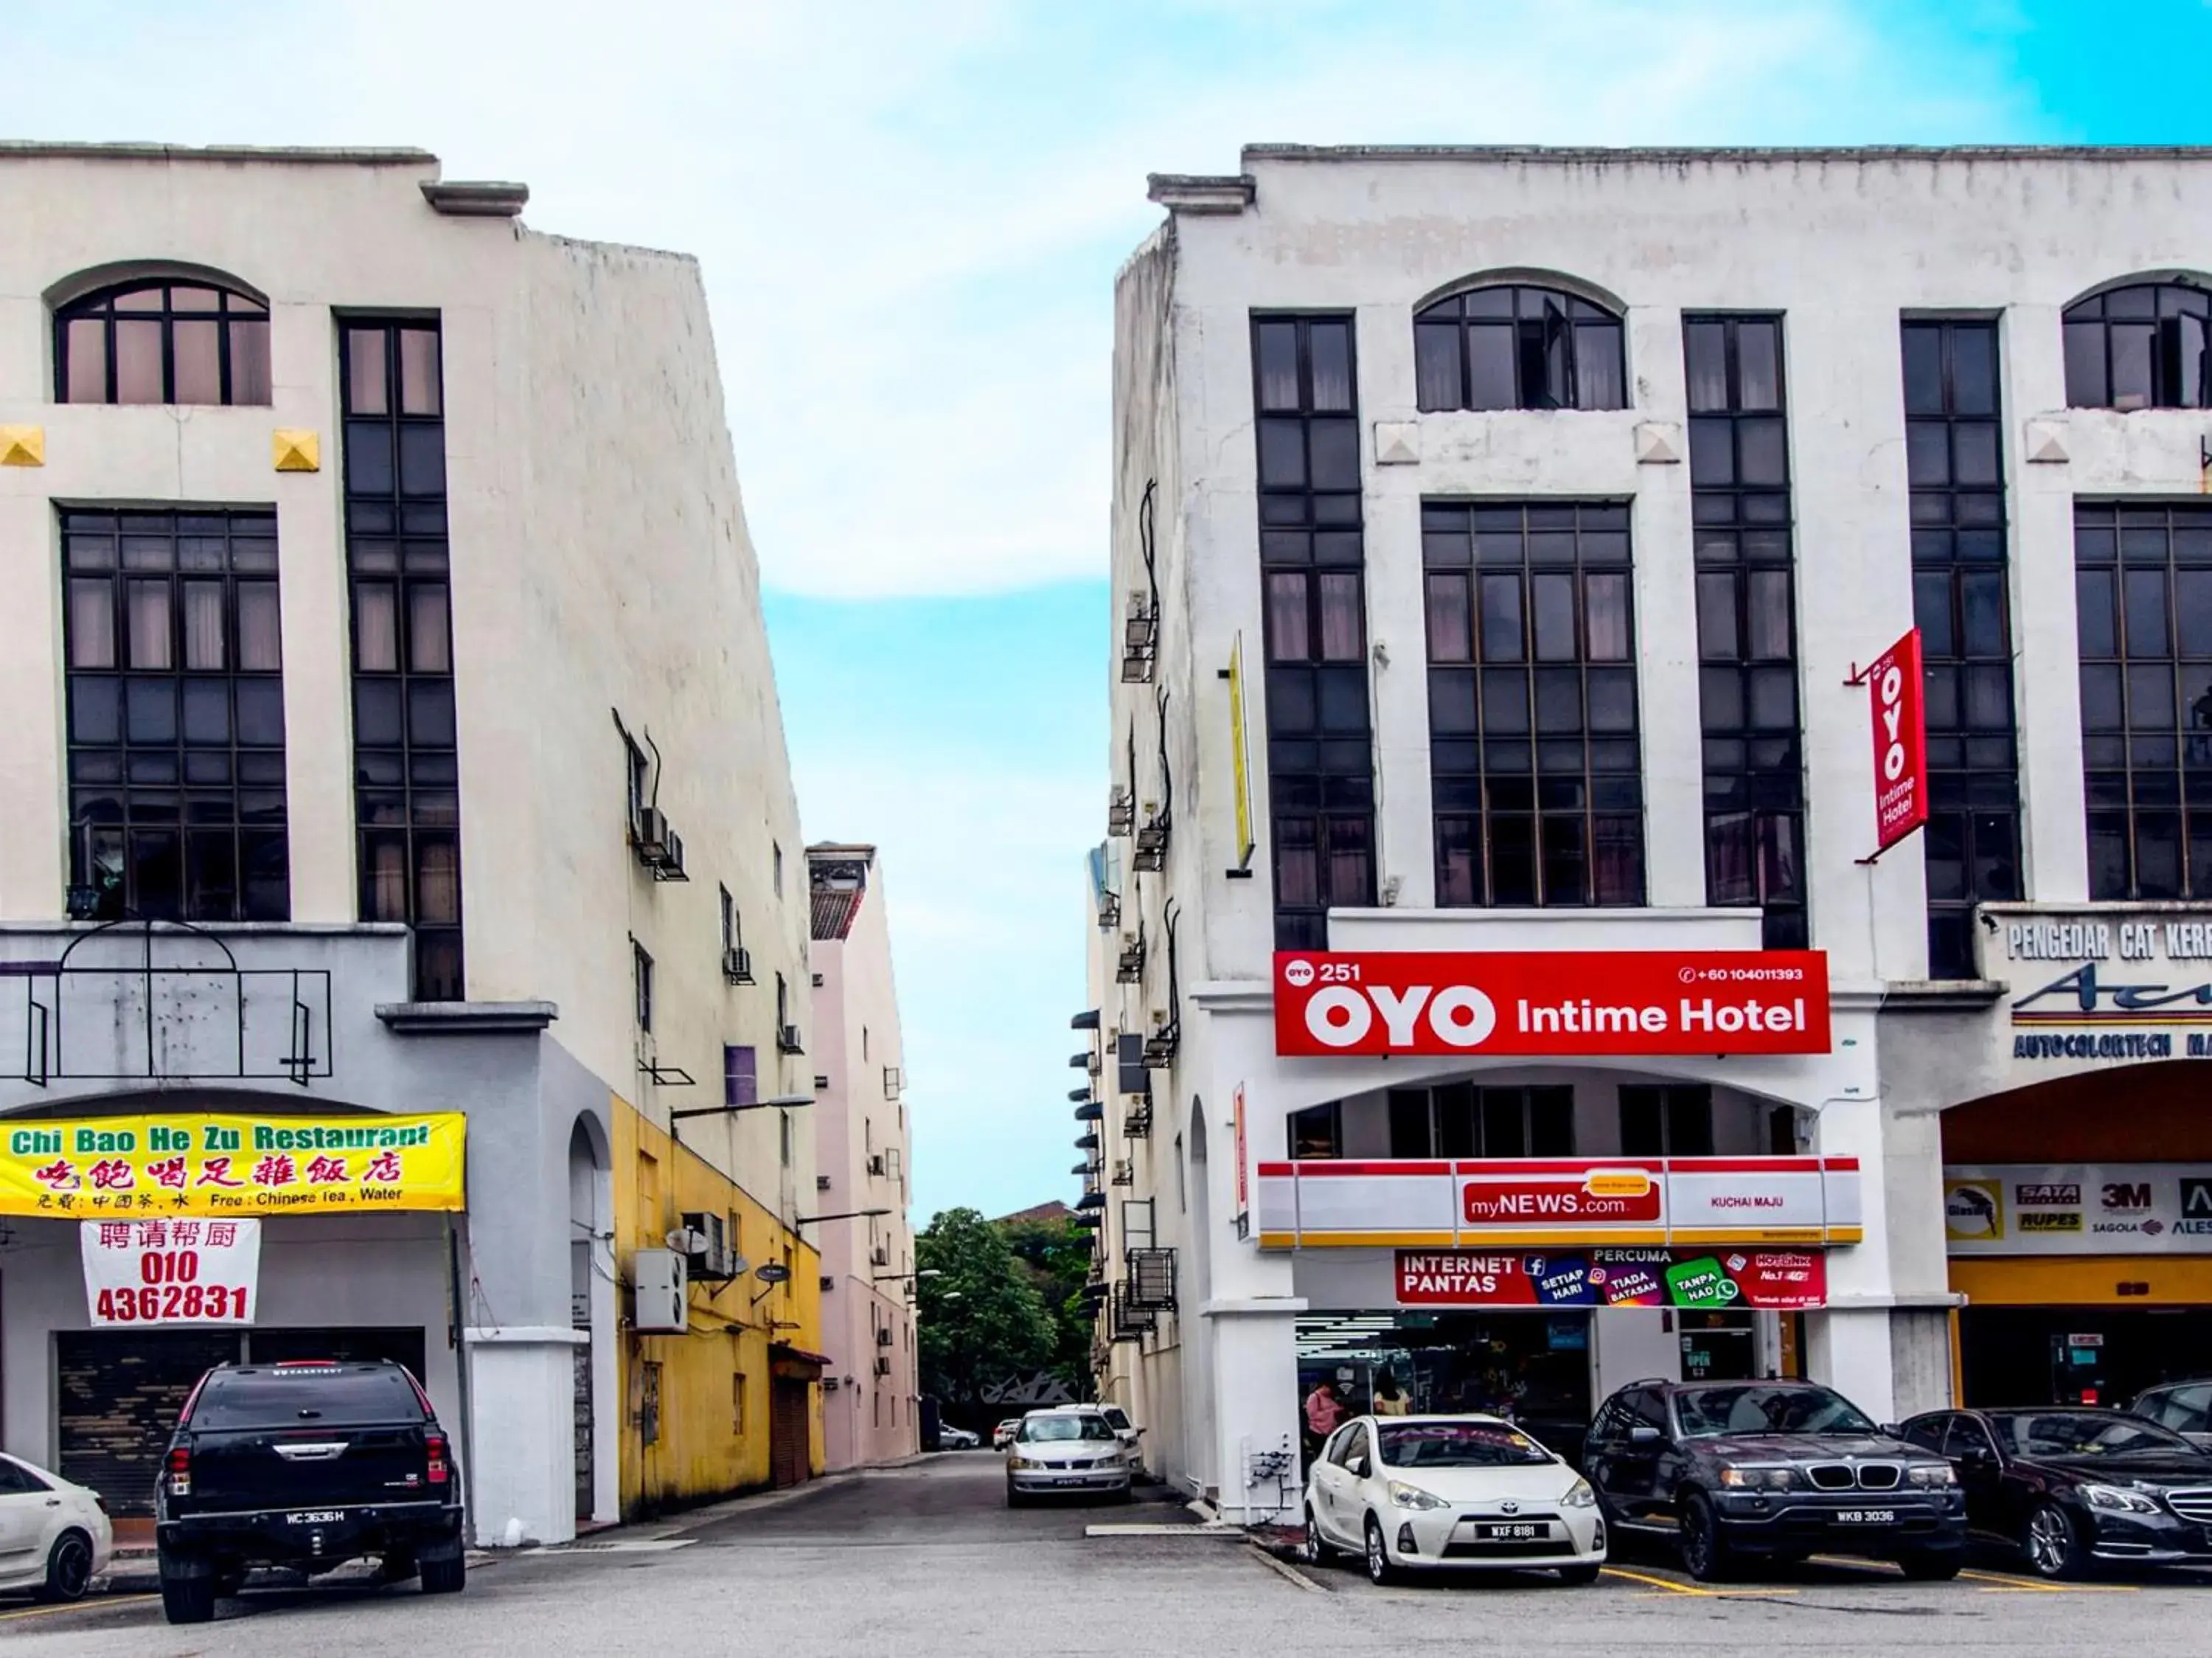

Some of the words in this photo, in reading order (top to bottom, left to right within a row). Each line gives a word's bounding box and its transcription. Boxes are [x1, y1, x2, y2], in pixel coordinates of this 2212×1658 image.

[1882, 666, 1905, 781] OYO
[1879, 777, 1915, 811] Intime
[1883, 792, 1913, 827] Hotel
[2008, 923, 2110, 960] PENGEDAR
[2119, 923, 2157, 960] CAT
[1320, 963, 1360, 981] 251
[1731, 968, 1803, 980] 104011393
[1304, 985, 1497, 1047] OYO
[1517, 999, 1668, 1033] Intime
[1680, 997, 1806, 1032] Hotel
[12, 1130, 61, 1154] Chi
[77, 1129, 135, 1152] Bao
[150, 1127, 190, 1151] He
[204, 1126, 240, 1150] Zu
[254, 1125, 428, 1149] Restaurant
[36, 1151, 401, 1189] 吃飽喝足雜飯店
[211, 1193, 243, 1206] Free
[256, 1193, 316, 1205] Chinese
[360, 1188, 403, 1200] Water
[1711, 1197, 1751, 1207] KUCHAI
[1754, 1197, 1783, 1207] MAJU
[2022, 1186, 2077, 1197] SATA
[2101, 1183, 2152, 1207] 3M
[1471, 1194, 1625, 1217] myNEWS.com
[100, 1221, 237, 1249] 聘请帮厨
[2093, 1222, 2138, 1232] SAGOLA
[1404, 1256, 1516, 1274] INTERNET
[1593, 1249, 1672, 1263] PERCUMA
[141, 1251, 198, 1284] 010
[1404, 1275, 1497, 1292] PANTAS
[1542, 1269, 1585, 1290] SETIAP
[1610, 1271, 1649, 1289] TIADA
[1677, 1272, 1717, 1291] TANPA
[1551, 1283, 1583, 1300] HARI
[1610, 1281, 1658, 1303] BATASAN
[1688, 1286, 1714, 1301] HAD
[97, 1286, 247, 1321] 4362831
[286, 1513, 303, 1525] WC
